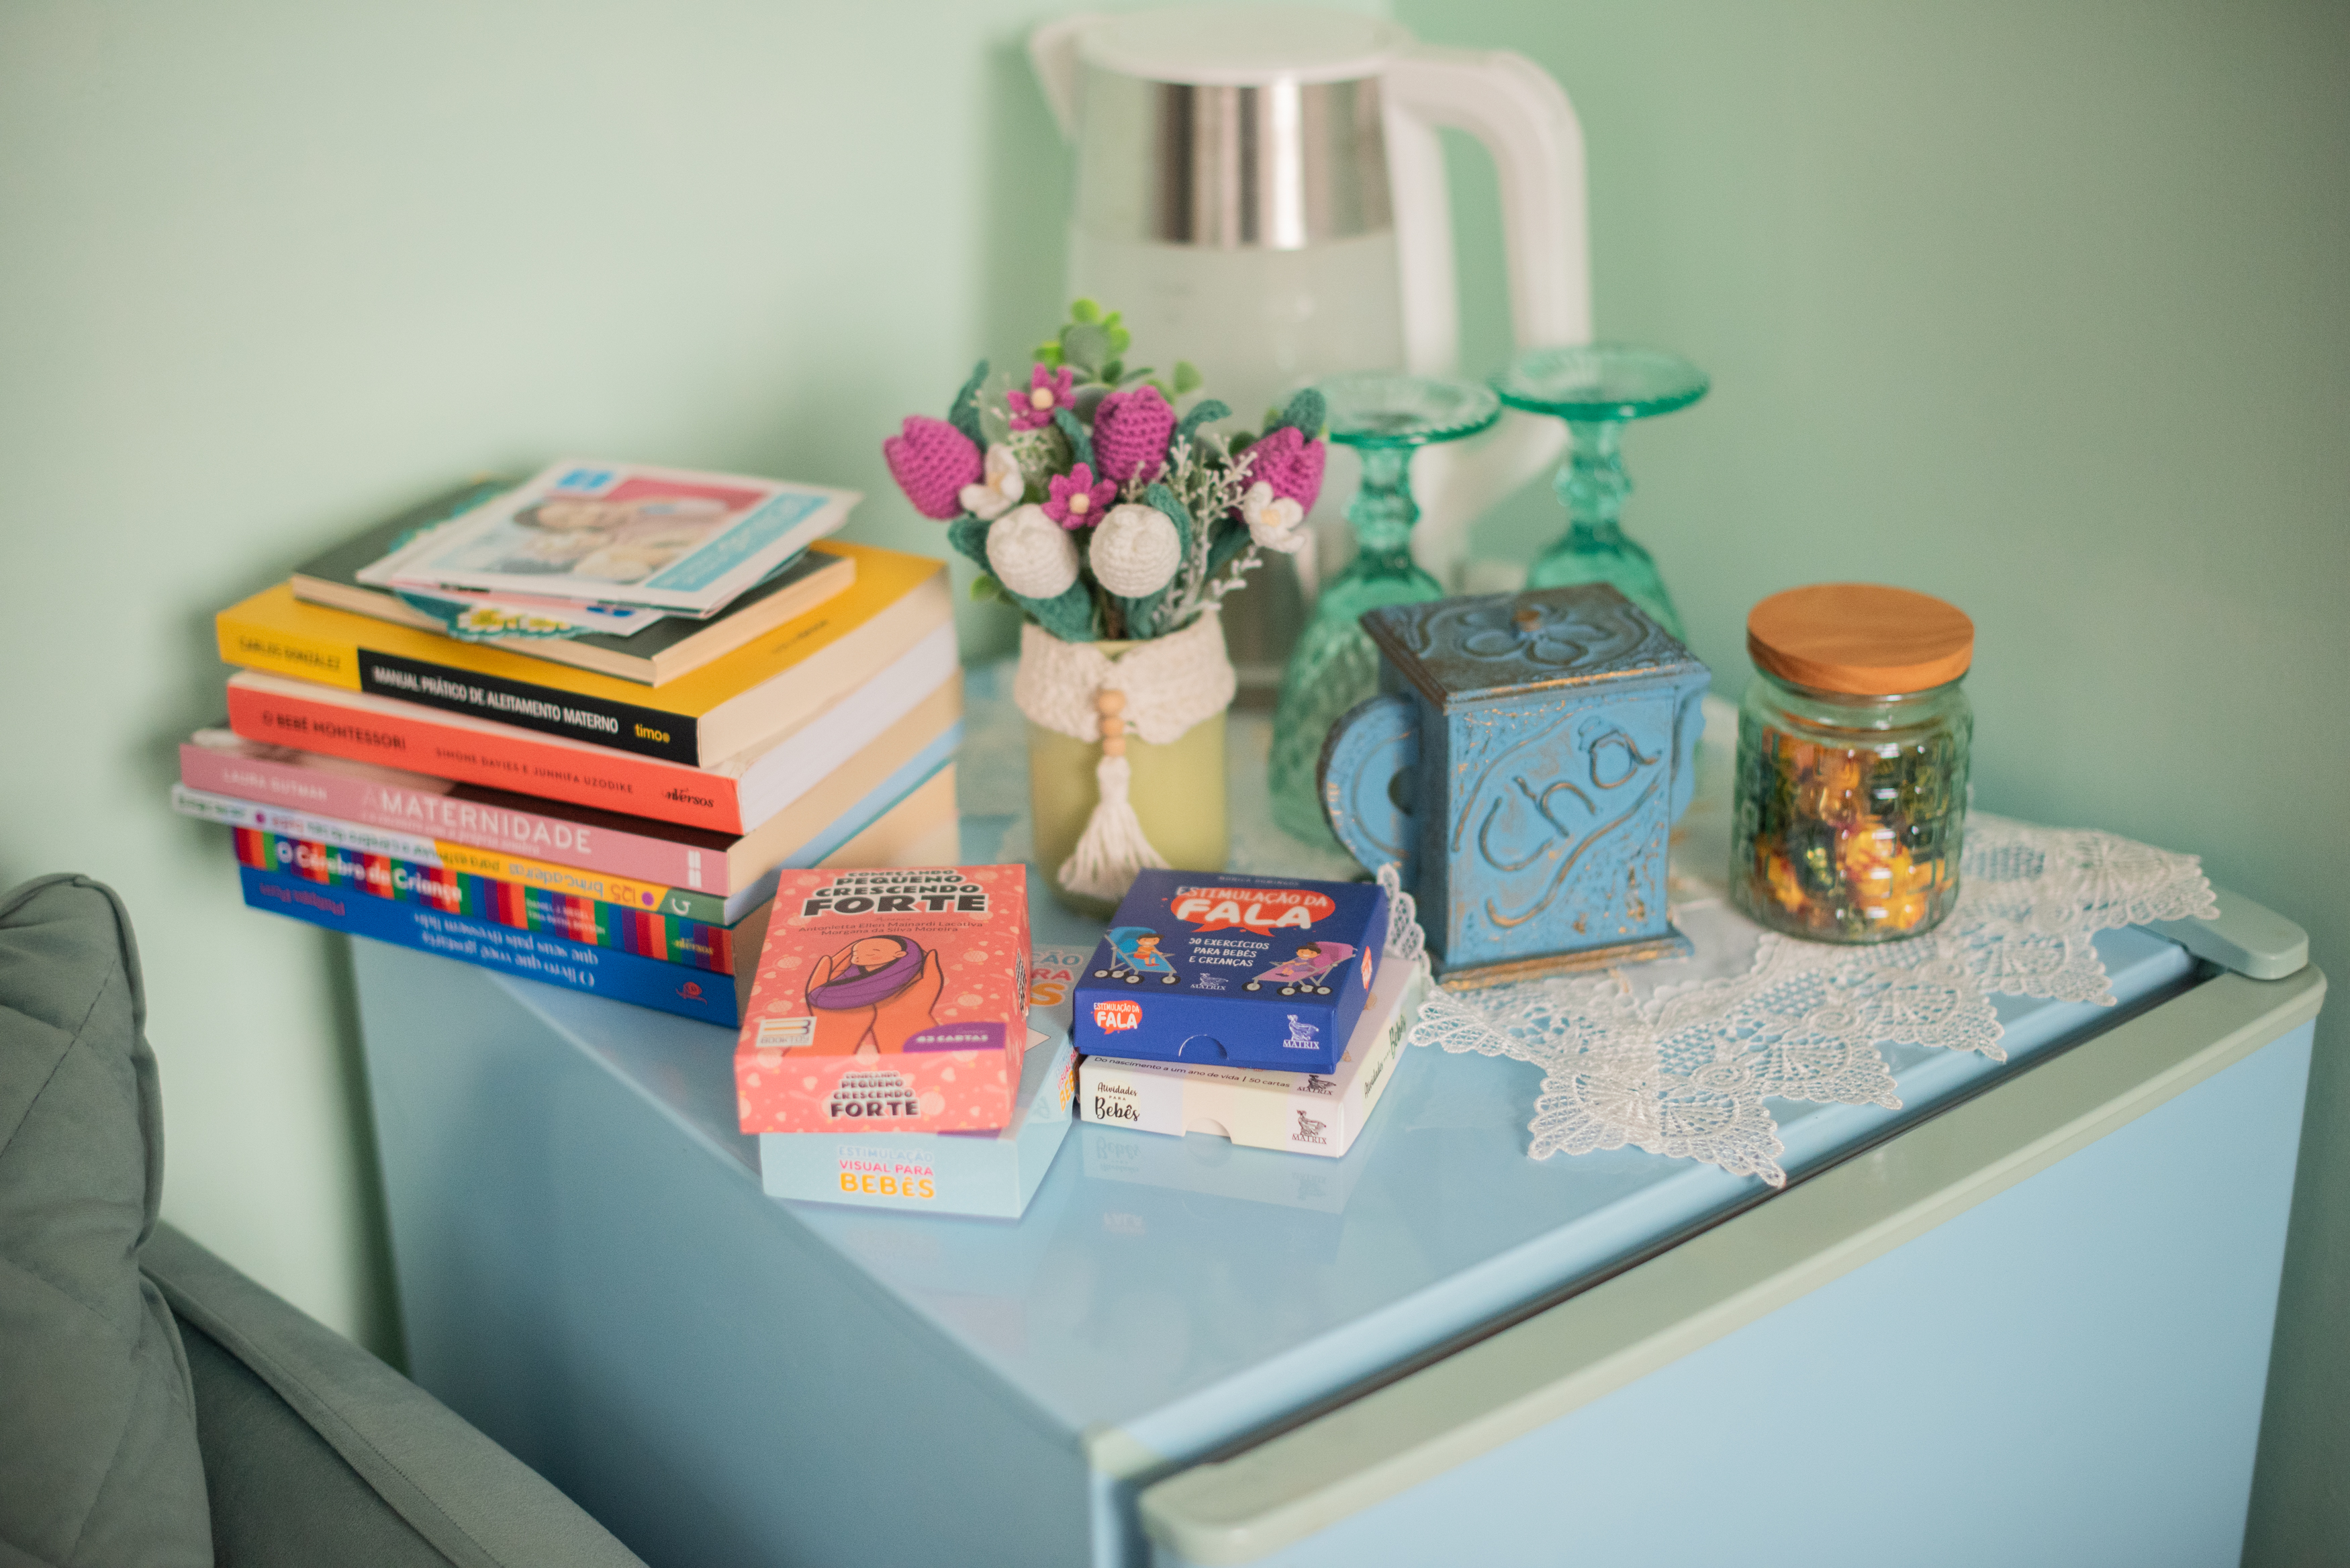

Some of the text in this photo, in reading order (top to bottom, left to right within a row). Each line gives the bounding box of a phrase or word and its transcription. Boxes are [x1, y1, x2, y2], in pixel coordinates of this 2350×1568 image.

[372, 667, 618, 734] MANUAL PRÁTICO DE ALEITAMENTO MATERNO
[313, 720, 406, 750] MONTESSORI
[481, 757, 520, 773] DAVIES
[534, 767, 580, 783] JUNNIFA
[583, 776, 633, 794] UZODIKE
[382, 789, 592, 855] MATERNIDADE
[275, 841, 463, 906] O Cérebro da Criança
[508, 863, 606, 896] brincadeiras
[836, 875, 963, 886] PEQUENO
[610, 883, 637, 905] 125
[815, 885, 980, 897] CRESCENDO
[1176, 886, 1327, 908] ESTIMULAÇÃO DA
[804, 895, 986, 916] FORTE
[1176, 899, 1311, 929] FALA
[798, 922, 856, 932] Antonietta
[1194, 947, 1258, 958] PARA BEBÊS
[1204, 939, 1270, 950] EXERCÍCIOS
[514, 951, 542, 969] que
[570, 946, 599, 964] que
[1198, 957, 1254, 967] CRIANÇAS
[542, 962, 577, 982] livro
[577, 971, 595, 986] O
[1094, 1002, 1131, 1013] ESTIMULAÇÃO
[1097, 1012, 1137, 1029] FALA
[937, 1034, 989, 1043] CARTAS
[1283, 1040, 1320, 1050] MATRIX
[1109, 1059, 1162, 1070] nascimento
[1262, 1079, 1290, 1087] cartas
[841, 1079, 904, 1088] PEQUENO
[1060, 1069, 1076, 1112] BEB
[1098, 1082, 1137, 1096] Atividades
[1297, 1086, 1333, 1095] MATRIX
[833, 1089, 912, 1099] CRESCENDO
[831, 1101, 919, 1117] FORTE
[1095, 1096, 1140, 1122] Bebês
[1292, 1133, 1327, 1145] MATRIX
[839, 1146, 934, 1163] ESTIMULAÇÃO
[839, 1159, 934, 1175] VISUAL PARA
[841, 1173, 935, 1198] BEBÊS
